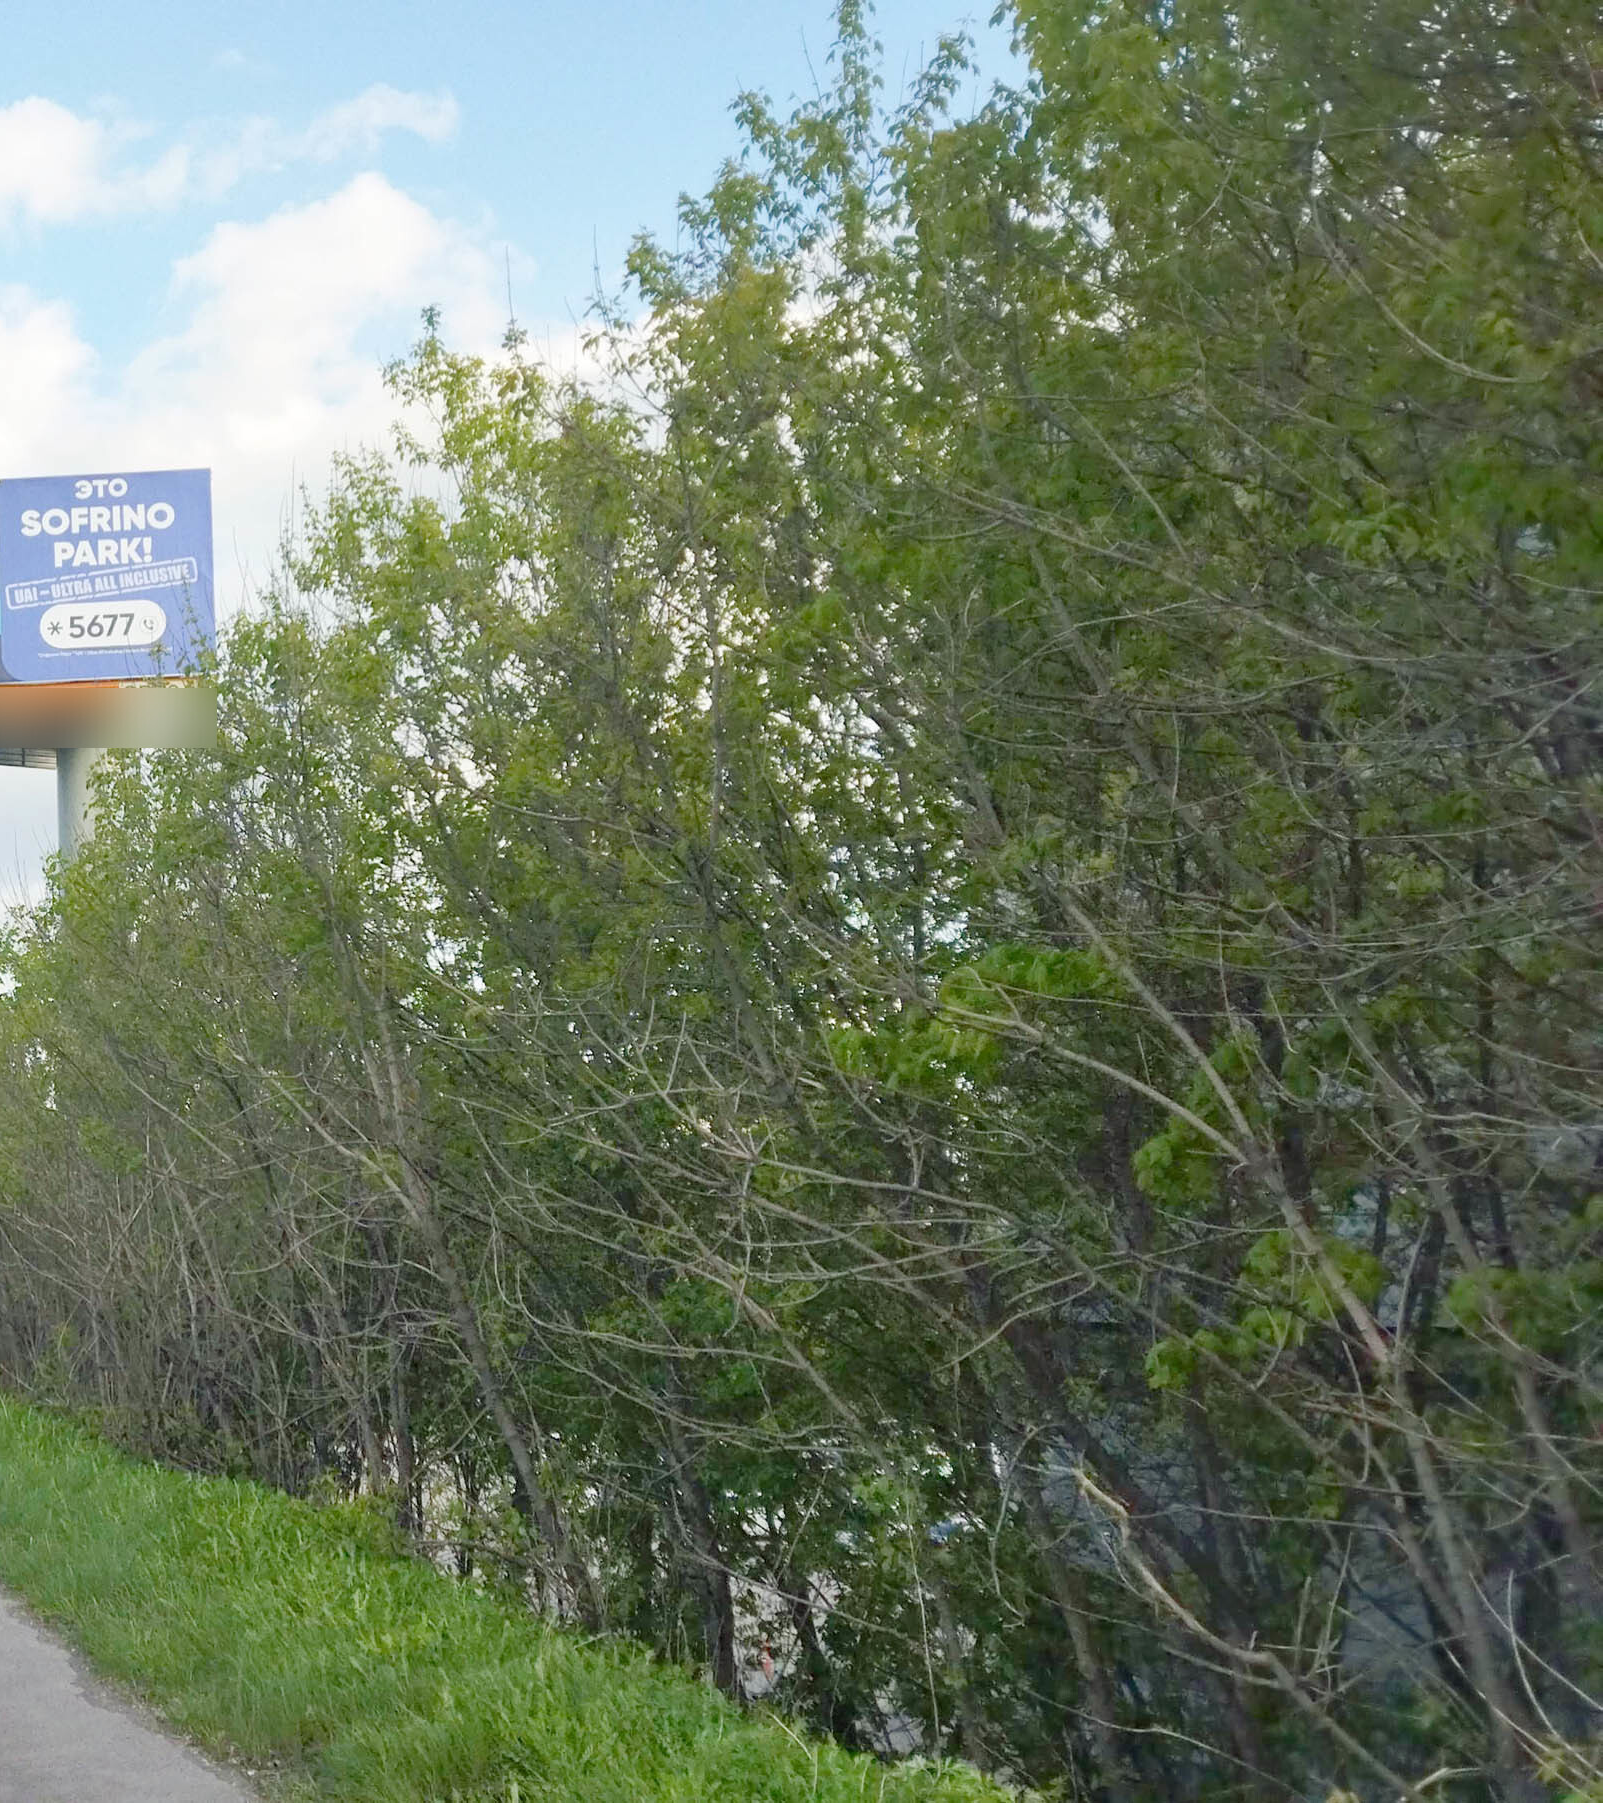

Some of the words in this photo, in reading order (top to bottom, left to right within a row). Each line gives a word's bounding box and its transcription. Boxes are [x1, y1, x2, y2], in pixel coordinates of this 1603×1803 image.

[74, 477, 128, 500] ЭТО
[20, 502, 175, 537] SOFRINO
[53, 537, 153, 568] PARK!
[14, 587, 38, 604] UAI
[51, 580, 92, 599] ULTRA
[94, 575, 118, 593] ALL
[119, 563, 190, 589] INCLUSIVE
